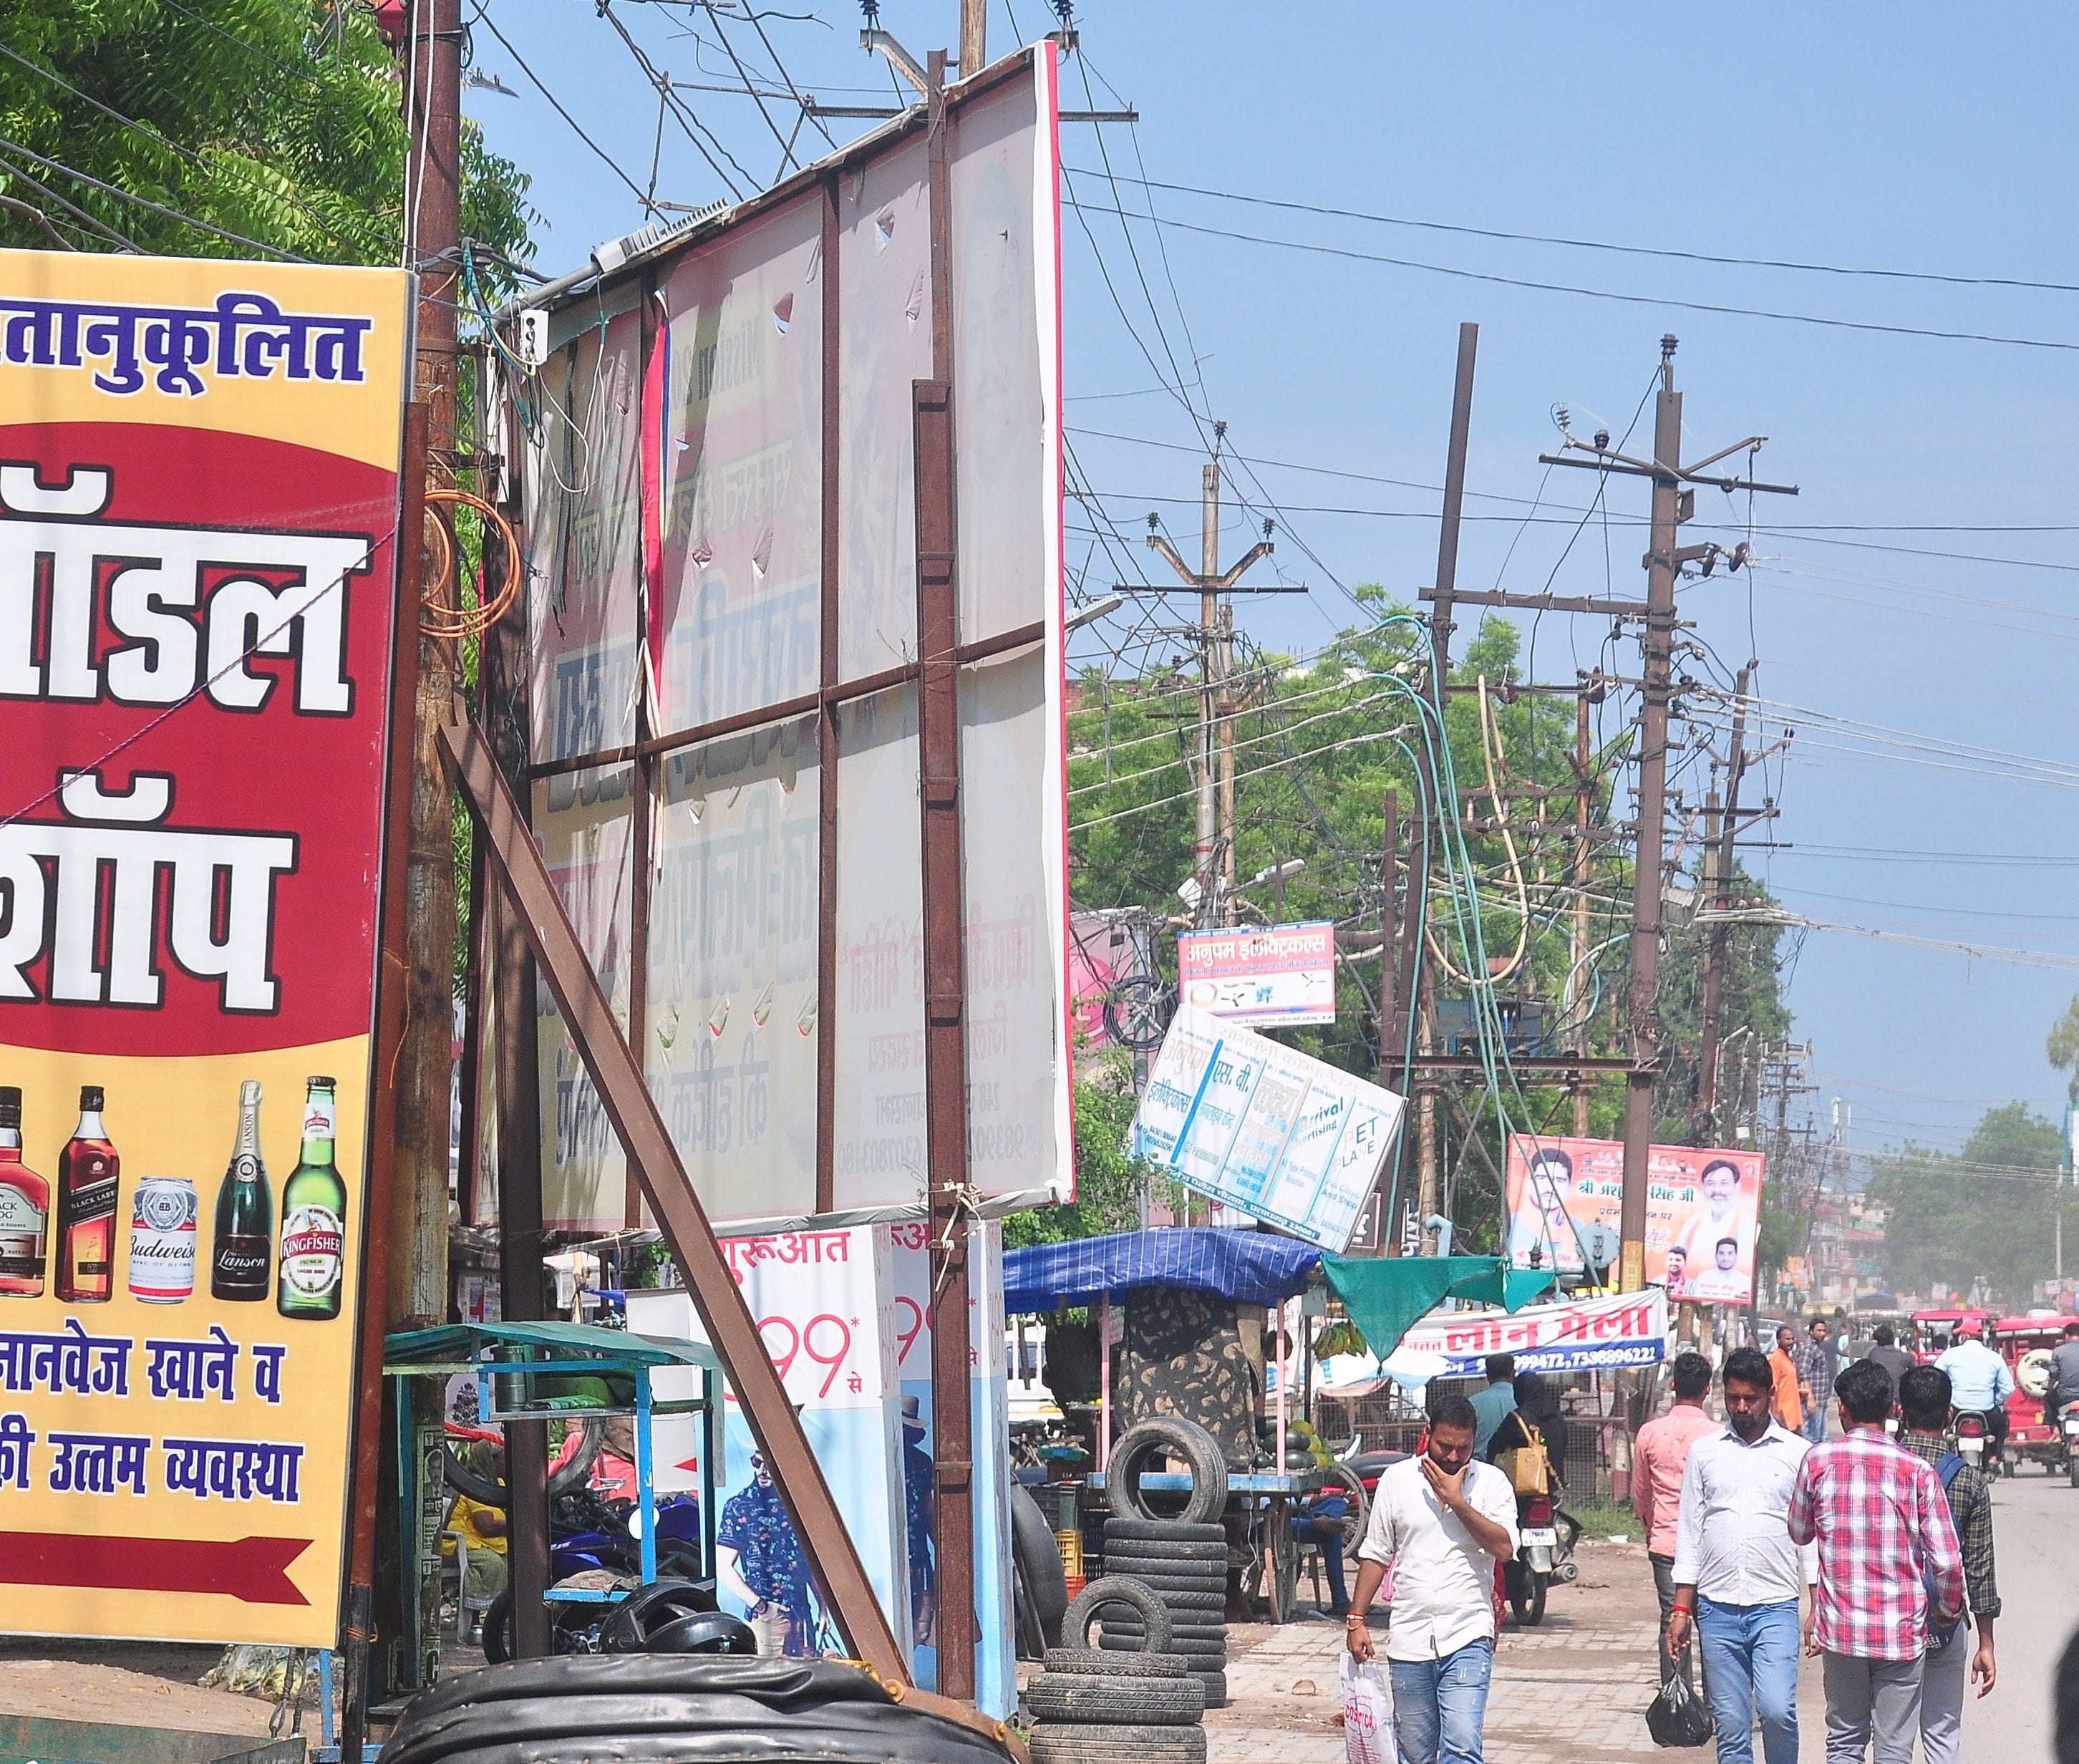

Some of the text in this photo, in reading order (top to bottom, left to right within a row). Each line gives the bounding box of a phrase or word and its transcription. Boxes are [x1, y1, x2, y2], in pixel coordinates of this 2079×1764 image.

[0, 293, 371, 396] तानुकूलित
[0, 772, 294, 1010] शॉप
[1186, 941, 1236, 967] अनुपम
[1163, 1039, 1210, 1075] अनुपम
[243, 1113, 253, 1148] LANSON
[1344, 1116, 1379, 1149] PET
[97, 1189, 115, 1201] LABE
[1321, 1188, 1357, 1210] And Shop
[1579, 1179, 1695, 1203] श्री अंशु सिंह जी
[1661, 1212, 1672, 1221] पर
[216, 1248, 266, 1271] Lanson
[283, 1235, 341, 1256] KINGFISHER
[1443, 1304, 1652, 1351] लोन मेला
[145, 1326, 239, 1400] खाने
[253, 1346, 286, 1403] व
[847, 1371, 862, 1393] से
[48, 1434, 151, 1494] उत्तम
[163, 1438, 304, 1502] व्यवस्था
